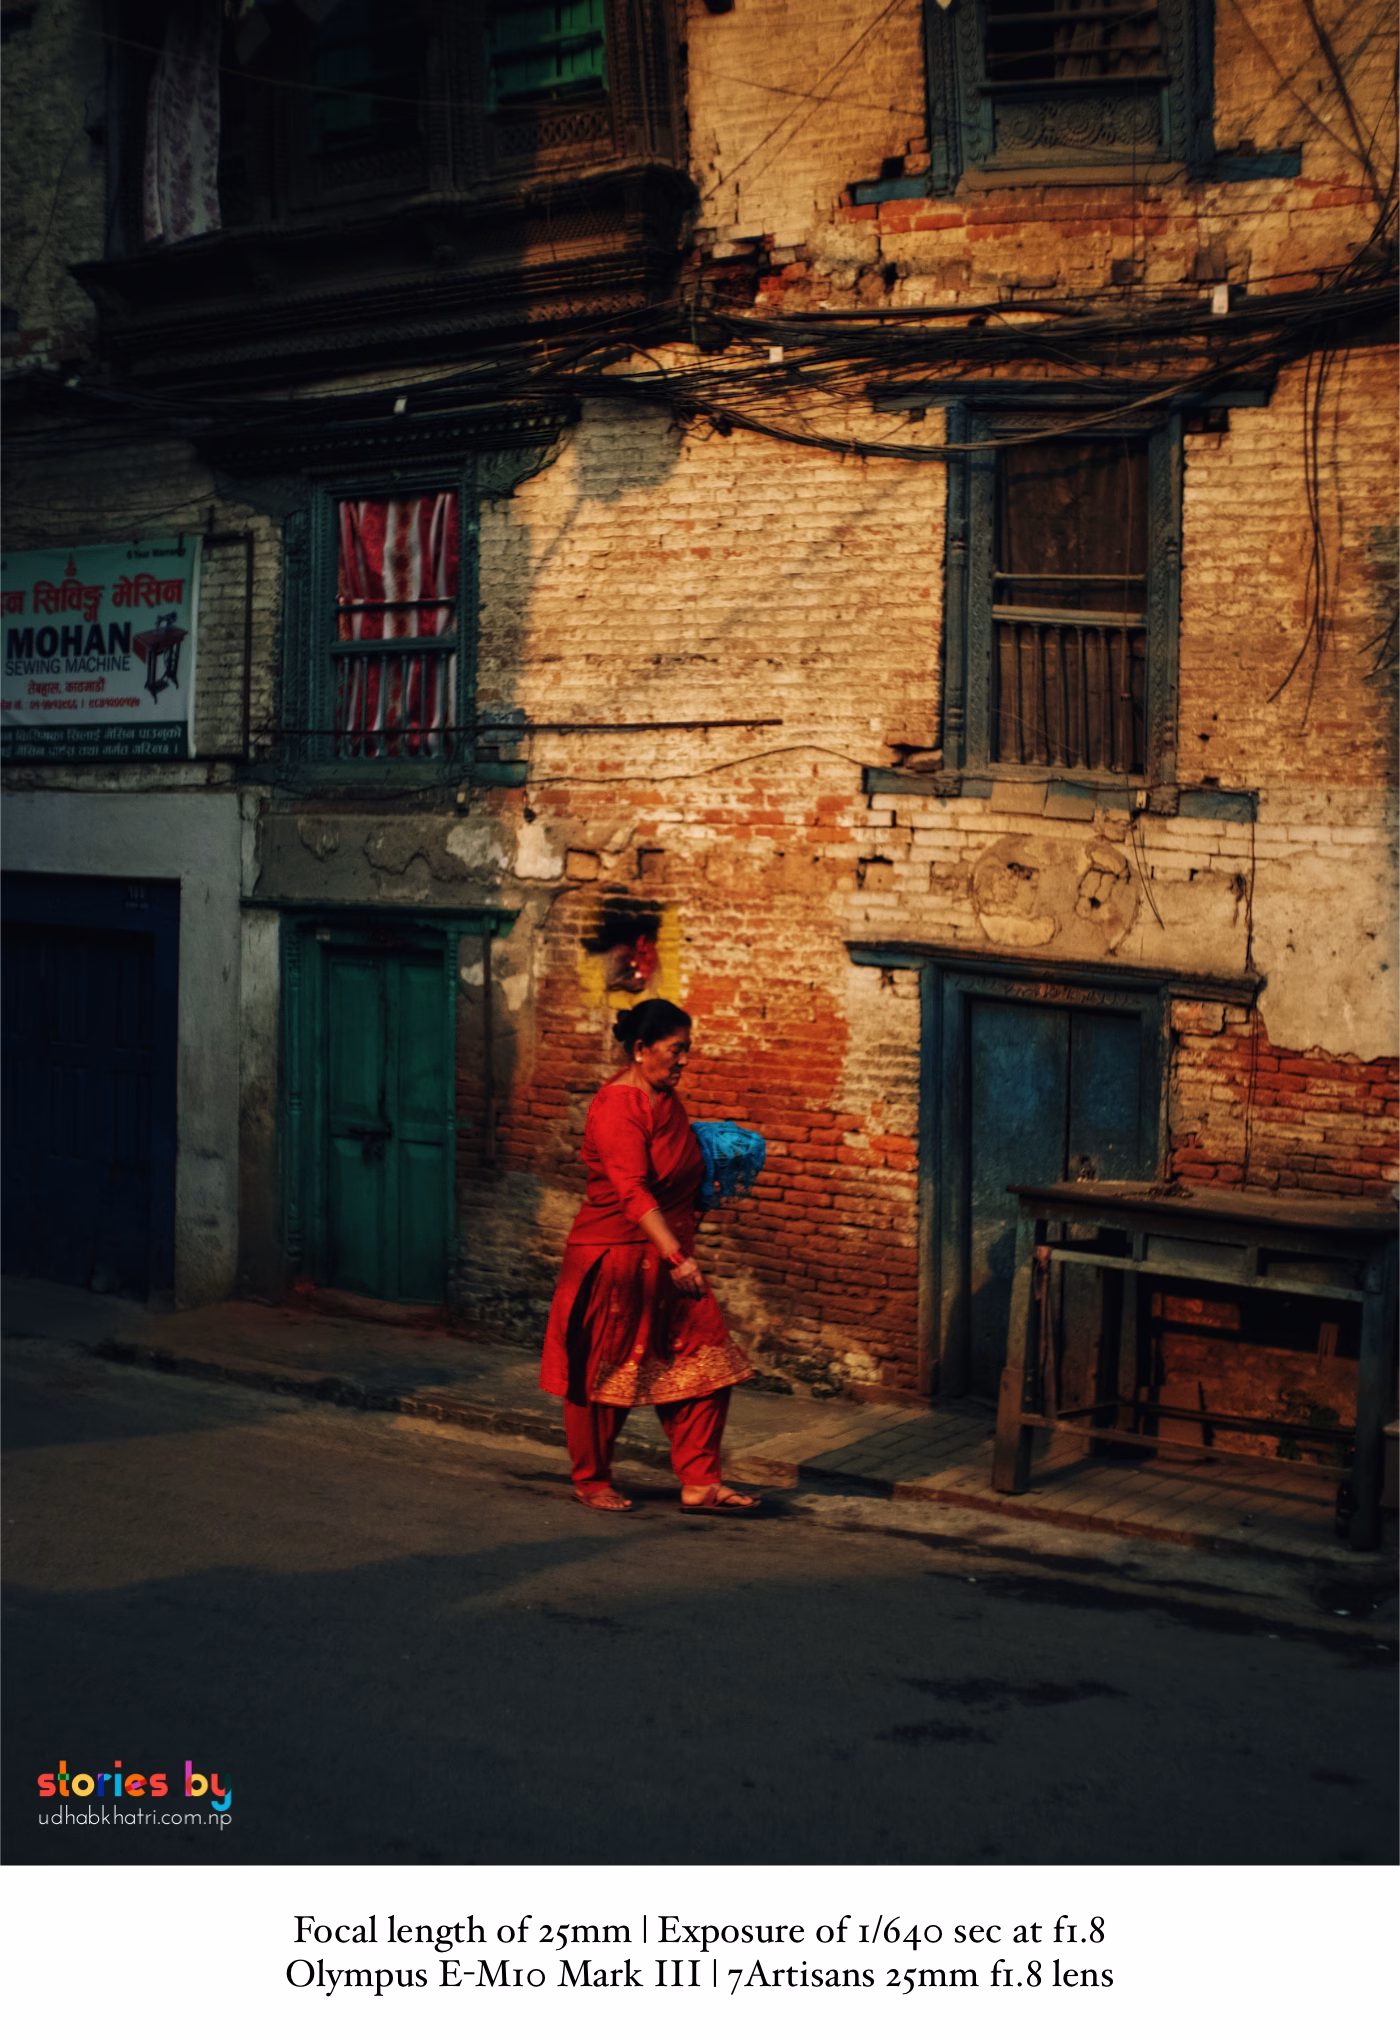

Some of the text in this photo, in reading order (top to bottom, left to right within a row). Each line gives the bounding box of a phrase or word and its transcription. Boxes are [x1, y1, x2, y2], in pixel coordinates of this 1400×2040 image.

[112, 573, 186, 608] मेसिन
[7, 621, 131, 660] MOHAN
[5, 655, 131, 677] SEWING MACHINE
